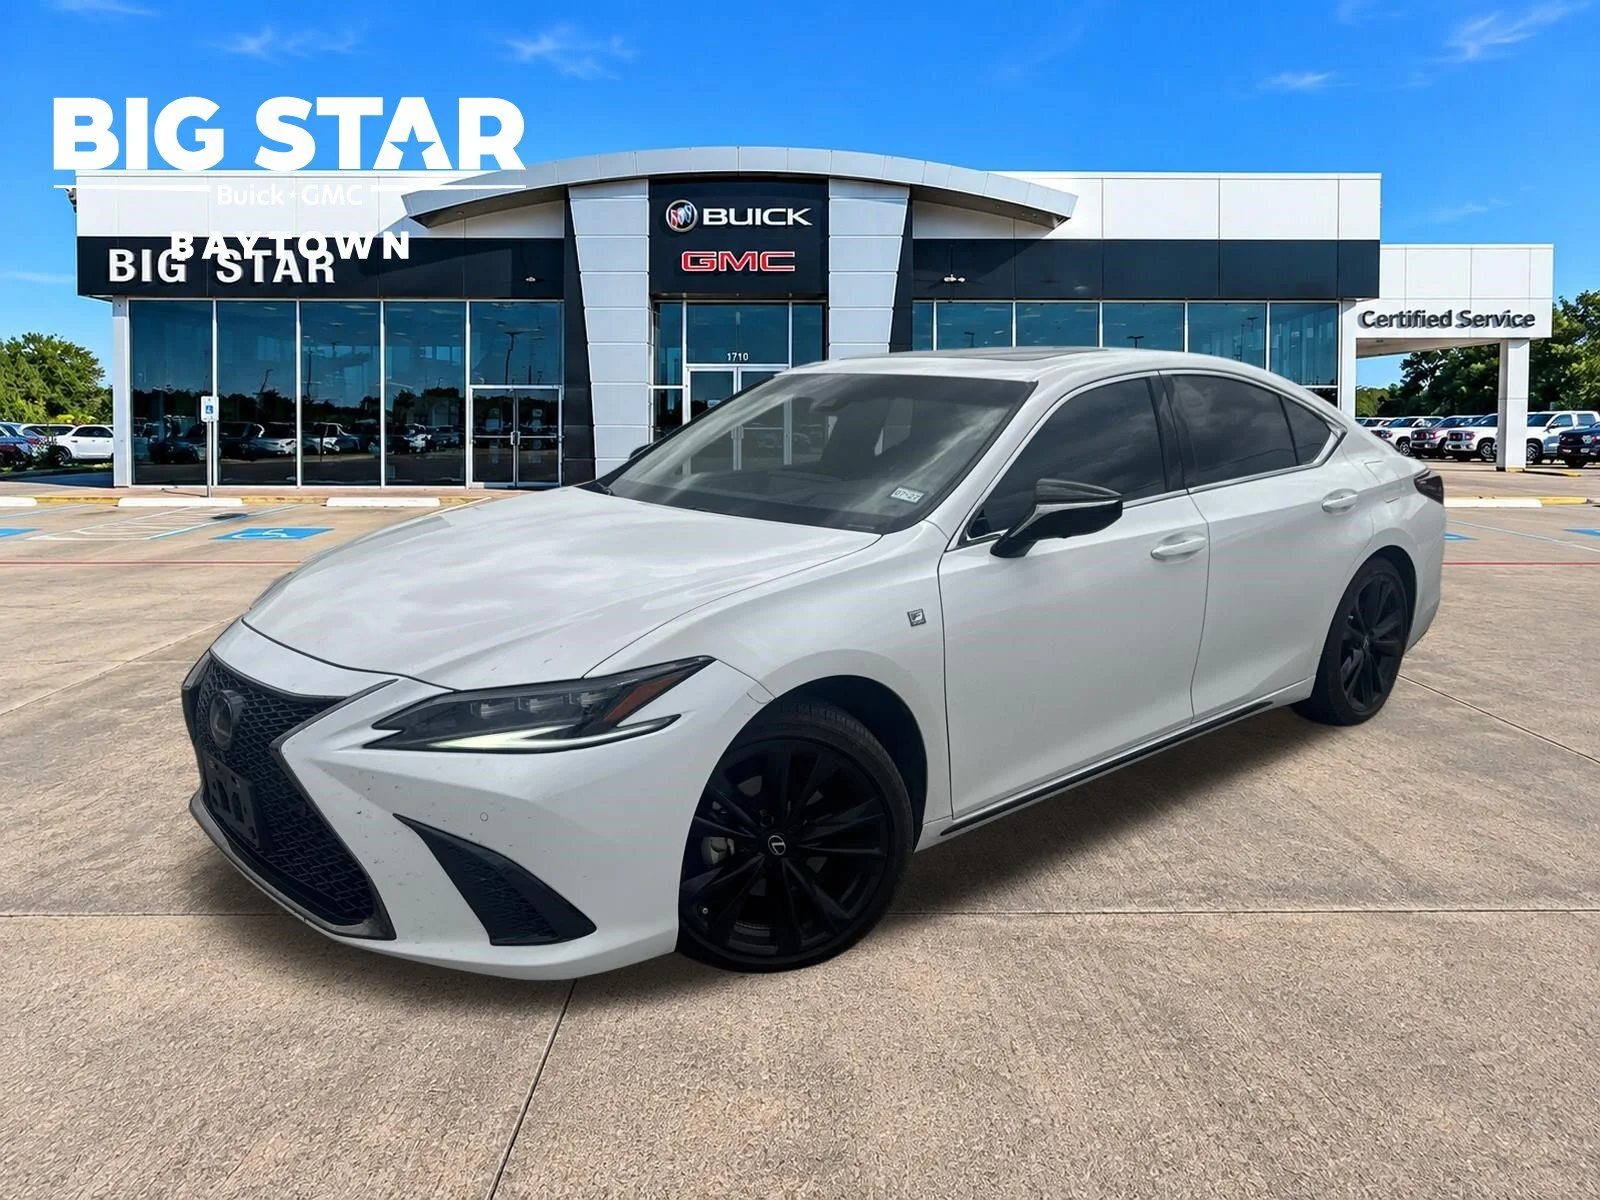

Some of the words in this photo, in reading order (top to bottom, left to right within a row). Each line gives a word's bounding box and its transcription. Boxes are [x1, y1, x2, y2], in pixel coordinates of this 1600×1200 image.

[702, 208, 813, 226] BUICK
[108, 248, 188, 283] BIG
[216, 248, 336, 283] STAR
[681, 251, 796, 272] GMC
[1360, 309, 1453, 328] Certified
[1456, 309, 1536, 328] Service
[726, 352, 749, 361] 1710
